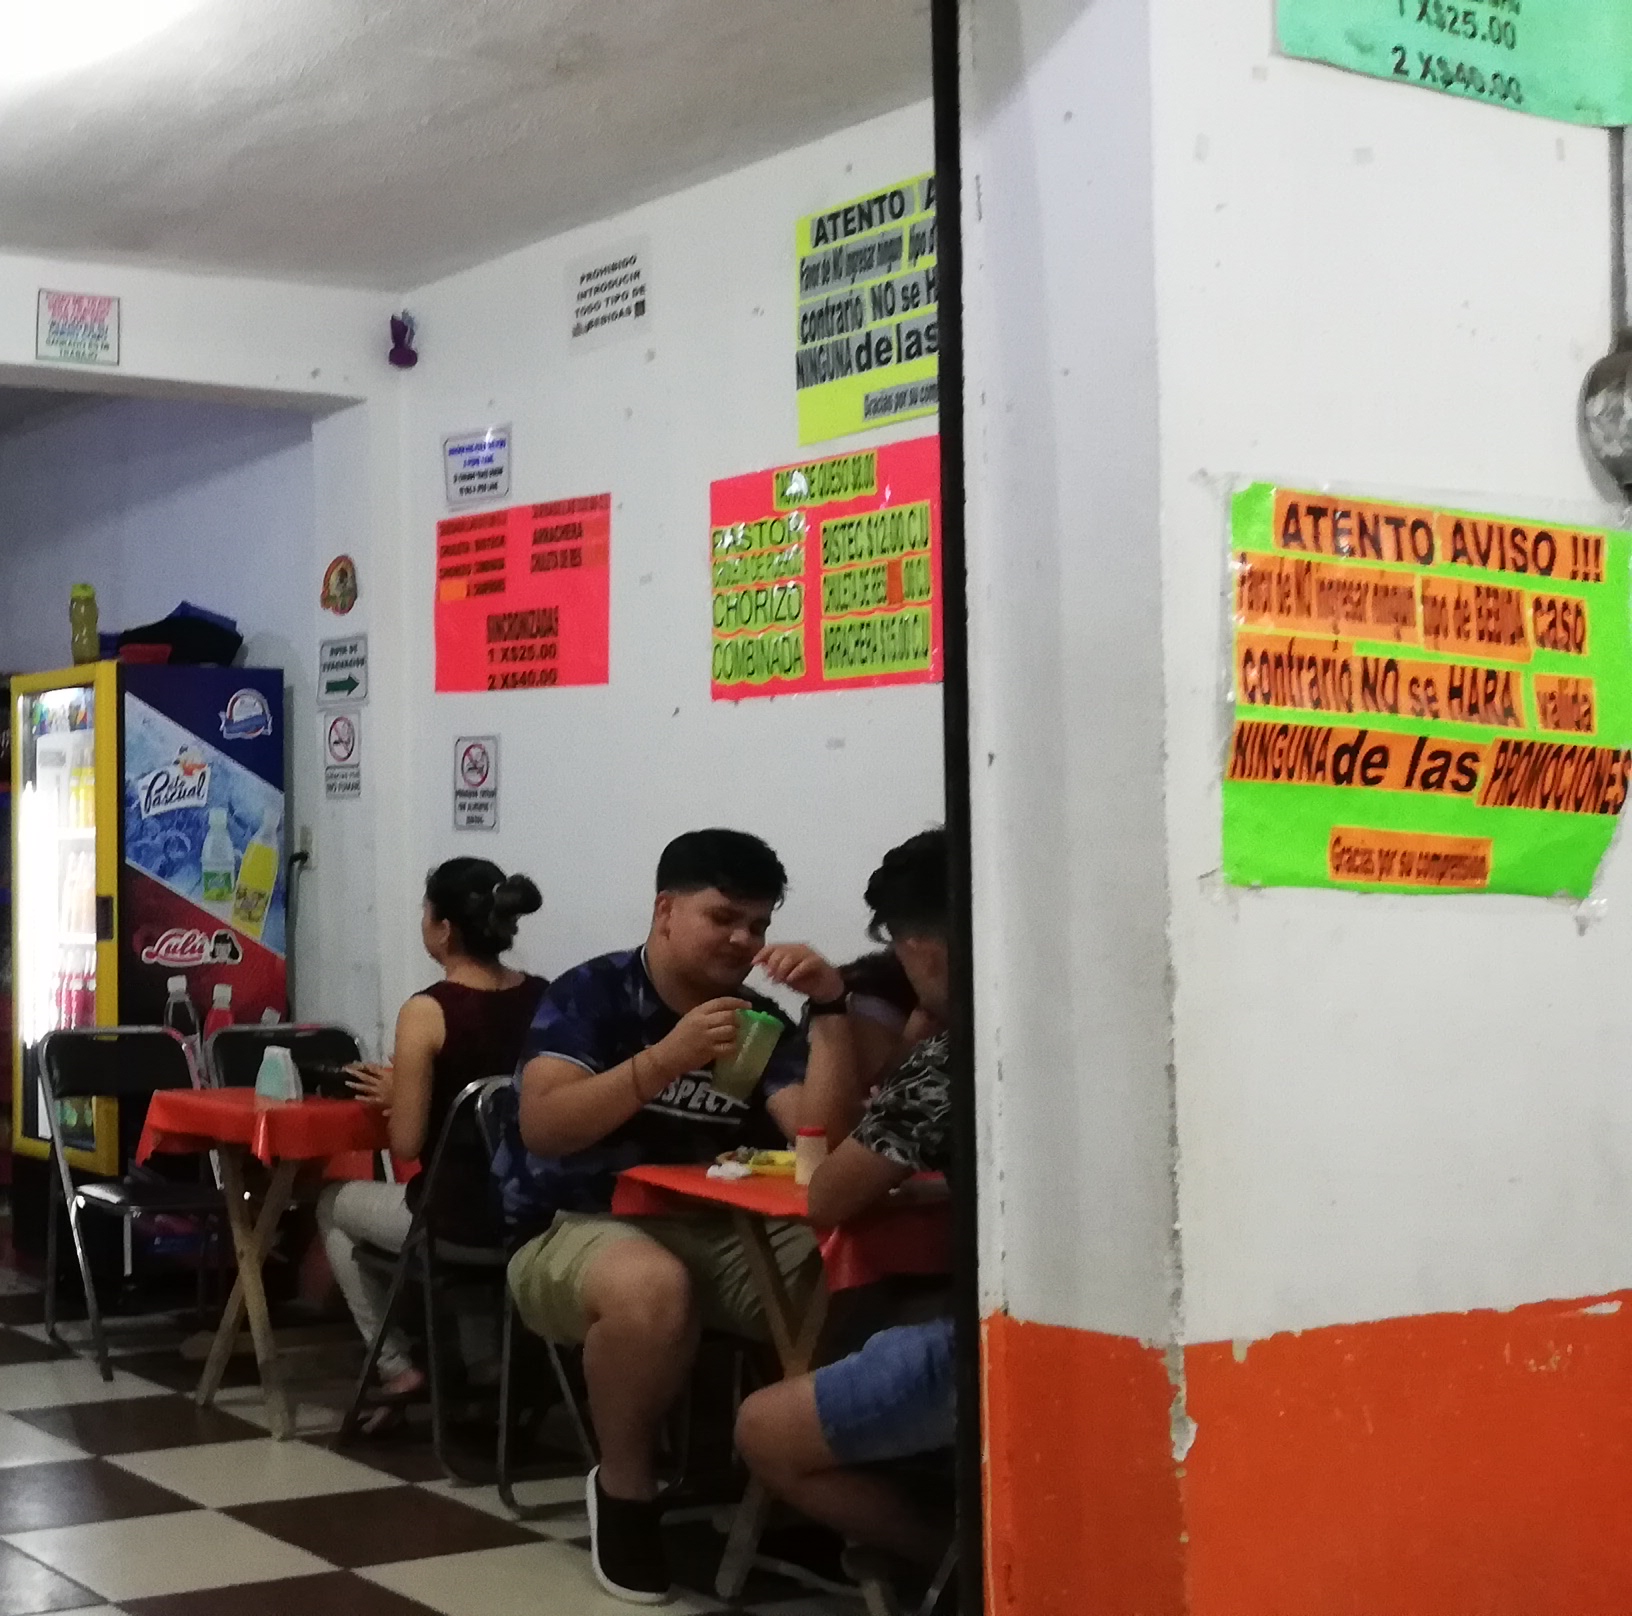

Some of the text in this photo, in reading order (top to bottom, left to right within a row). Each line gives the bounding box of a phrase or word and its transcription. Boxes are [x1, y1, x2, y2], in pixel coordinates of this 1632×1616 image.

[1392, 45, 1410, 77] 2
[813, 189, 906, 249] ATENTO
[577, 269, 641, 301] INTRODUCIR
[579, 254, 638, 286] PROHIBIDO
[575, 300, 602, 318] TODO
[605, 290, 630, 309] TIPO
[800, 288, 864, 345] contrario
[871, 281, 896, 322] NO
[901, 281, 920, 312] se
[855, 331, 894, 373] de
[1281, 502, 1603, 583] ATENTO AVISO !!!
[713, 583, 803, 629] CHORIZO
[1532, 598, 1586, 655] caso
[488, 648, 495, 663] 1
[713, 637, 802, 681] COMBINADA
[487, 673, 497, 691] 2
[1242, 636, 1354, 714] contrario
[1361, 656, 1400, 715] NO
[1408, 674, 1440, 719] se
[1447, 664, 1521, 728] HARA
[1229, 723, 1632, 815] NINGUNA de las PROMOCIONES
[144, 769, 207, 815] Pascual
